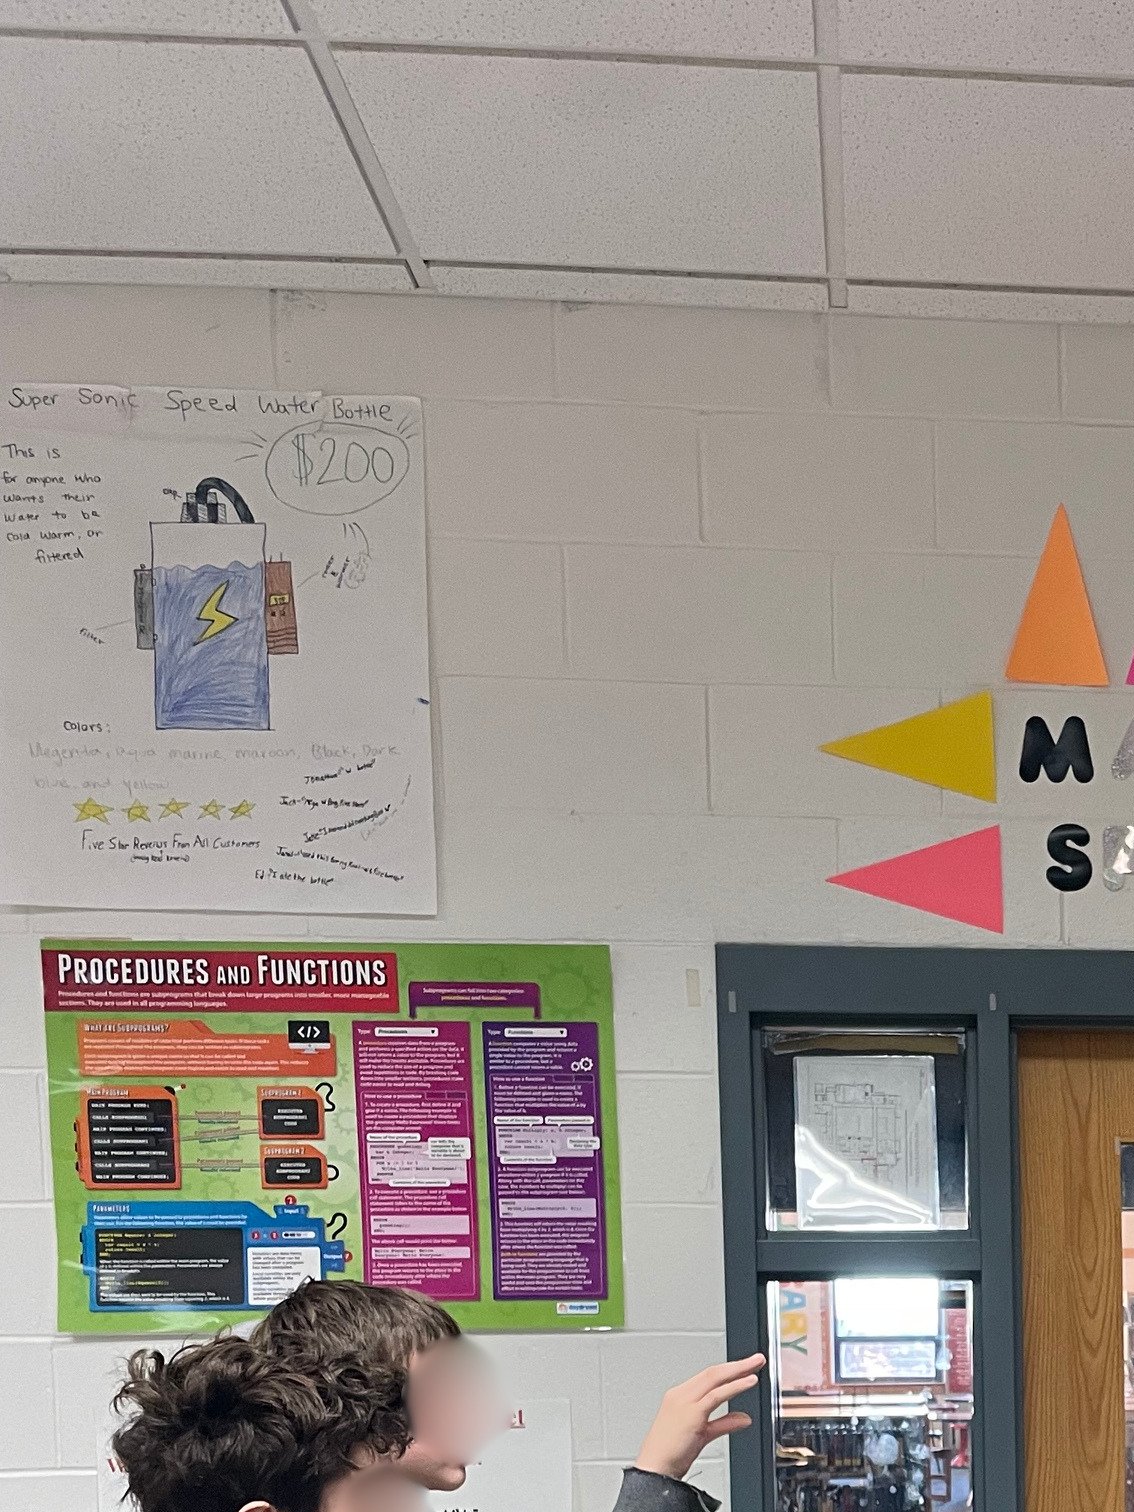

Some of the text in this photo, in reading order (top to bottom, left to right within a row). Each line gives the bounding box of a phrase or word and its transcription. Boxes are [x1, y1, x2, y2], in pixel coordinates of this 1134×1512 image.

[8, 387, 393, 421] Super Sonic Speed Water Bottle
[1, 443, 61, 459] This is
[291, 433, 394, 487] $200
[1, 471, 101, 487] for anyone who
[82, 829, 104, 850] Five
[212, 837, 260, 849] Customers
[58, 953, 209, 985] PROCEDURES
[257, 955, 386, 986] FUNCTIONS
